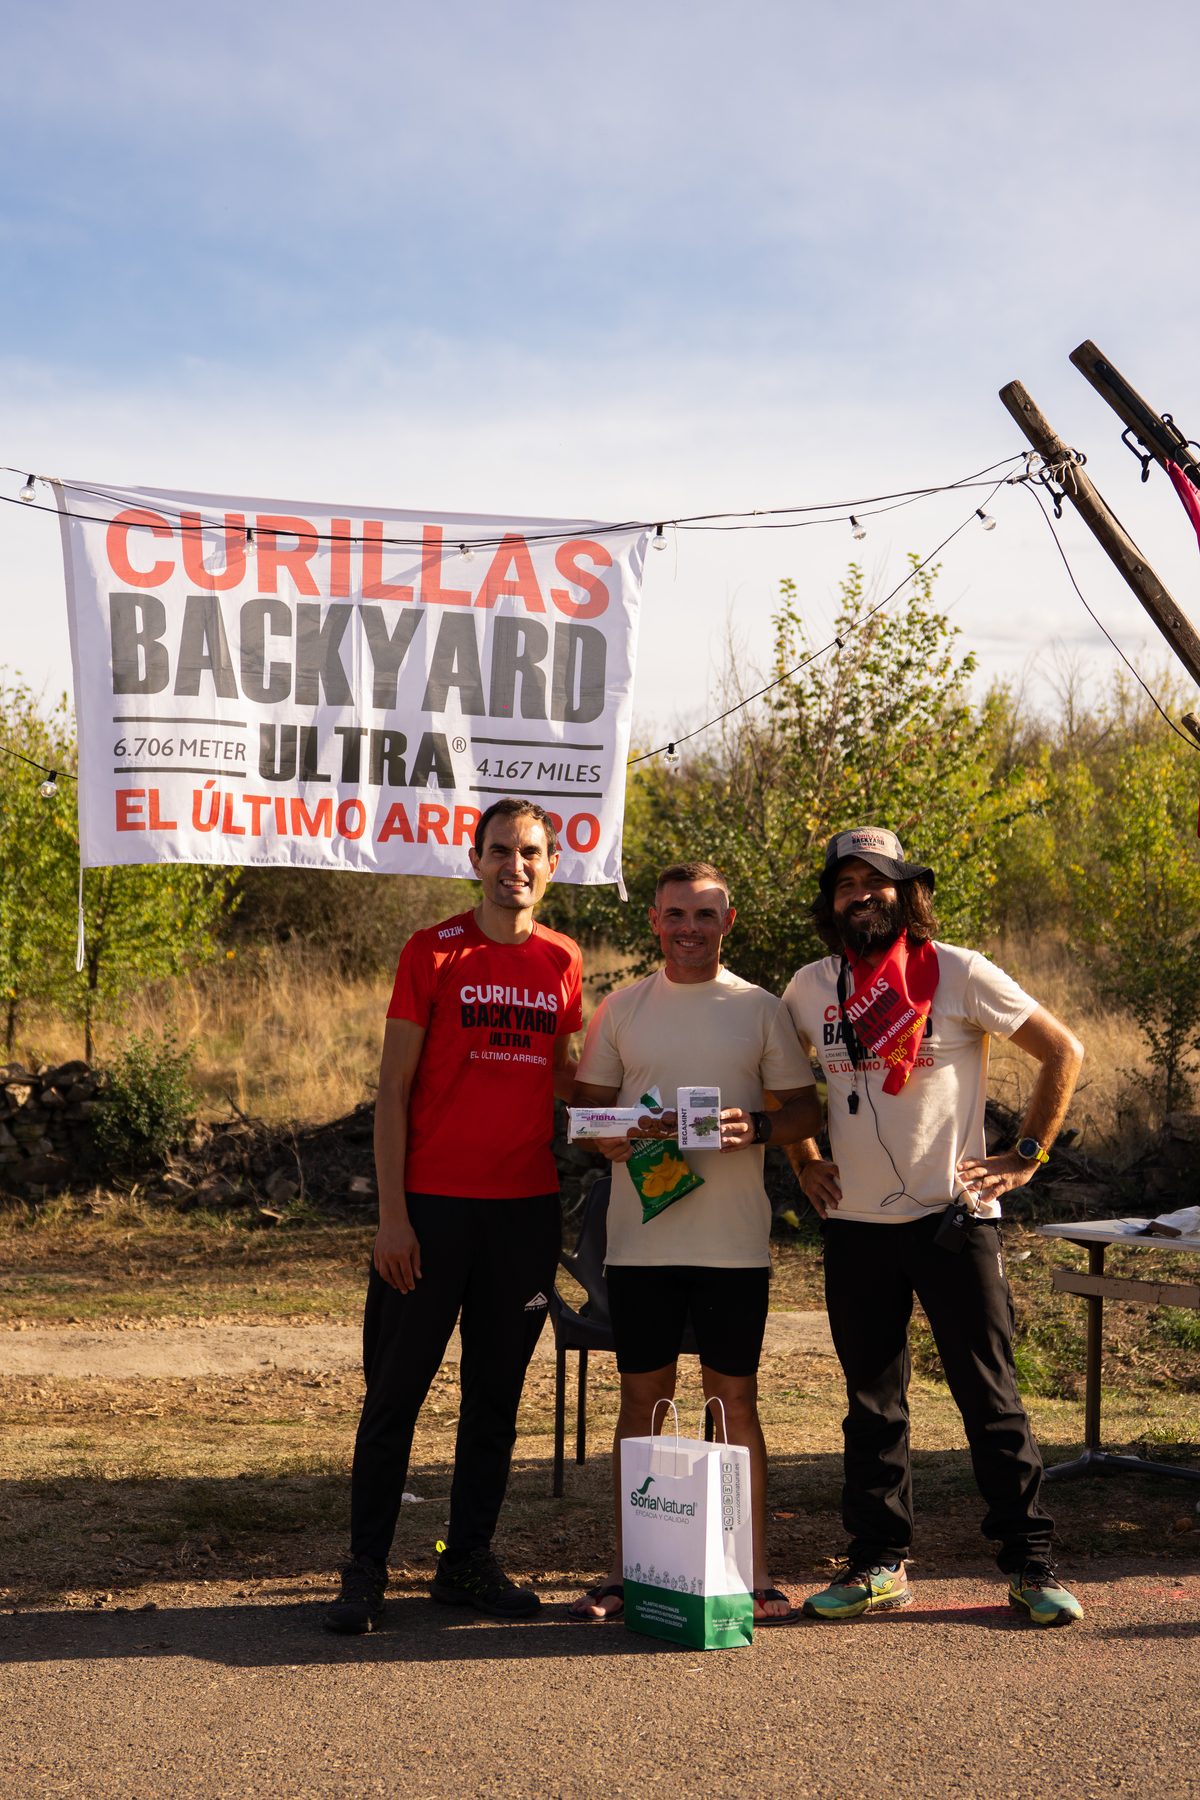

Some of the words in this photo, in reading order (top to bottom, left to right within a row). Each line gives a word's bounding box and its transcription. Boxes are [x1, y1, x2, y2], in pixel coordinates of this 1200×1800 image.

[106, 508, 613, 619] CURILLAS
[109, 592, 607, 723] BACKYARD
[113, 738, 174, 757] 6.706
[179, 738, 246, 761] METER
[476, 758, 533, 779] 4.167
[537, 763, 602, 783] MILES
[116, 788, 177, 832] EL
[192, 780, 366, 840] ÚLTIMO
[377, 802, 601, 853] ARRO
[460, 985, 558, 1012] CURILLAS
[461, 1004, 557, 1035] BACKYARD
[887, 1008, 916, 1038] ARRIERO
[897, 1014, 928, 1045] SOLIDARIA
[489, 1031, 531, 1048] ULTRA
[470, 1051, 479, 1059] EL
[512, 1053, 547, 1066] ARRIERO
[828, 1063, 839, 1074] EL
[840, 1060, 880, 1073] ÚLIMO
[888, 1045, 908, 1066] 2026
[663, 1514, 690, 1525] CALIDAD
